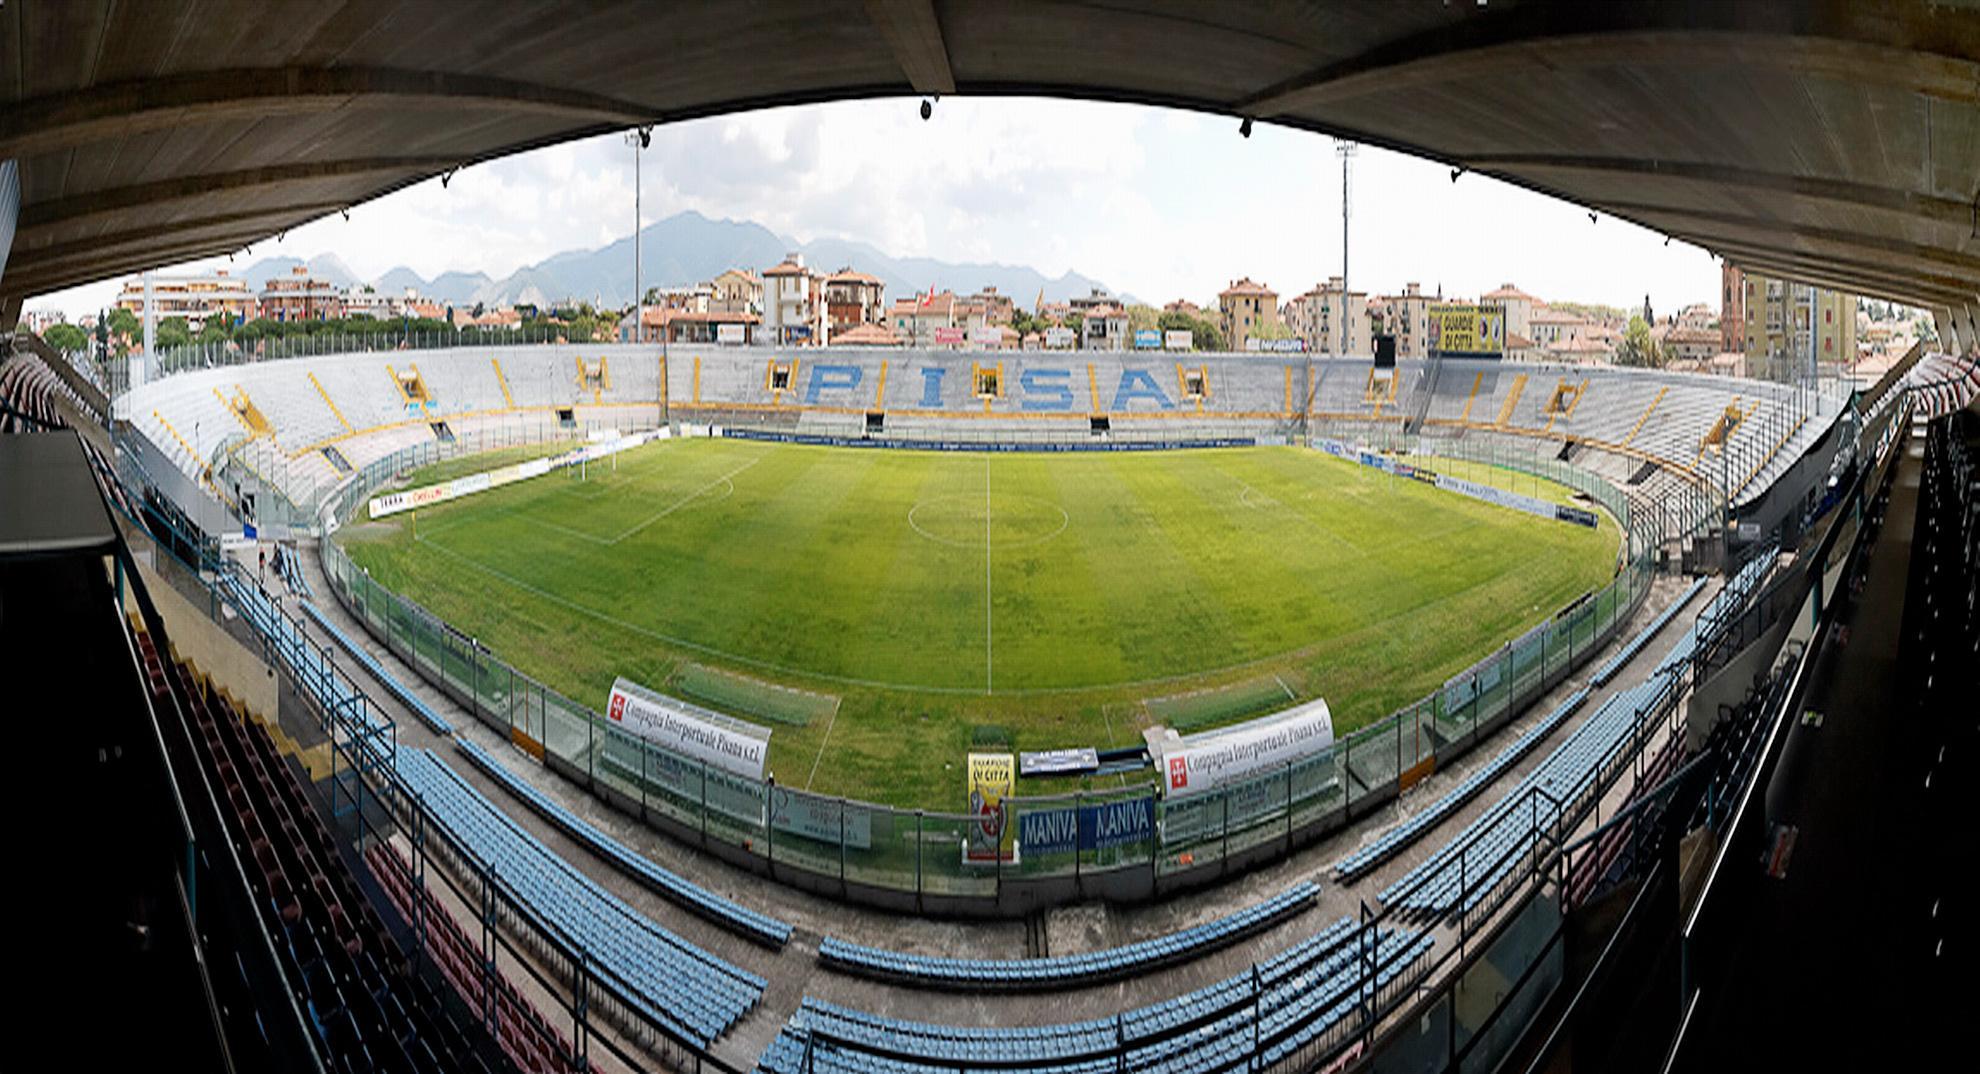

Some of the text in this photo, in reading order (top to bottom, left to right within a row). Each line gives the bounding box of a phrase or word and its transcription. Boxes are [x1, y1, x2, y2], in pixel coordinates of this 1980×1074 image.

[625, 699, 664, 729] Compagnia
[715, 733, 744, 759] Pisana
[1186, 747, 1234, 775] Compagnia
[1024, 809, 1077, 846] MANIVA
